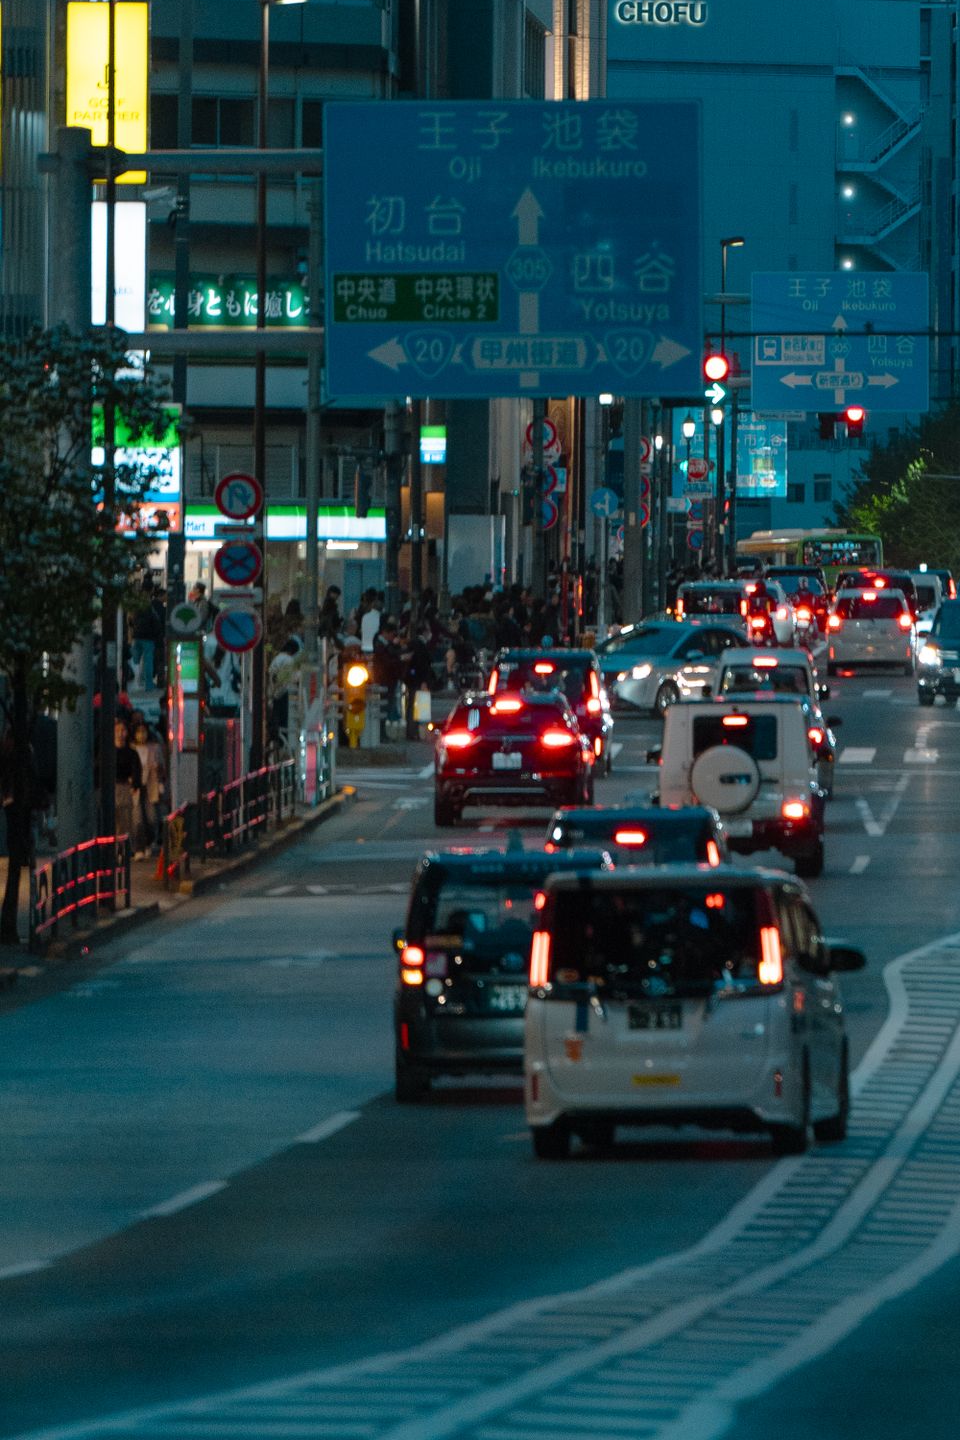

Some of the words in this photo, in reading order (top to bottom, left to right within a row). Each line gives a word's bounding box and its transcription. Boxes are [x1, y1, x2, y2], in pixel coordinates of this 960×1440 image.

[617, 0, 709, 25] CHOFU
[88, 96, 129, 108] GOF
[74, 110, 141, 121] PARNER
[418, 111, 512, 151] 王子
[542, 110, 639, 151] 池袋
[448, 157, 482, 183] Oji
[533, 157, 647, 179] Ikebukuro
[365, 195, 467, 236] 初台
[365, 240, 467, 263] Hatsudai
[513, 260, 547, 279] 305
[572, 252, 675, 293] 四谷
[336, 277, 397, 303] 中央道
[415, 276, 497, 302] 中央環状
[787, 278, 832, 298] 王子
[848, 278, 892, 298] 池袋
[346, 303, 388, 320] Chuo
[423, 303, 471, 320] Circle
[476, 303, 488, 320] 2
[580, 300, 670, 326] Yotsuya
[802, 299, 819, 312] Oji
[841, 300, 897, 311] Ikebukuro
[415, 338, 443, 361] 20
[614, 338, 644, 361] 20
[830, 341, 849, 352] 305
[867, 335, 916, 354] 四谷
[871, 357, 913, 369] Yotsuya
[186, 520, 206, 531] Mart
